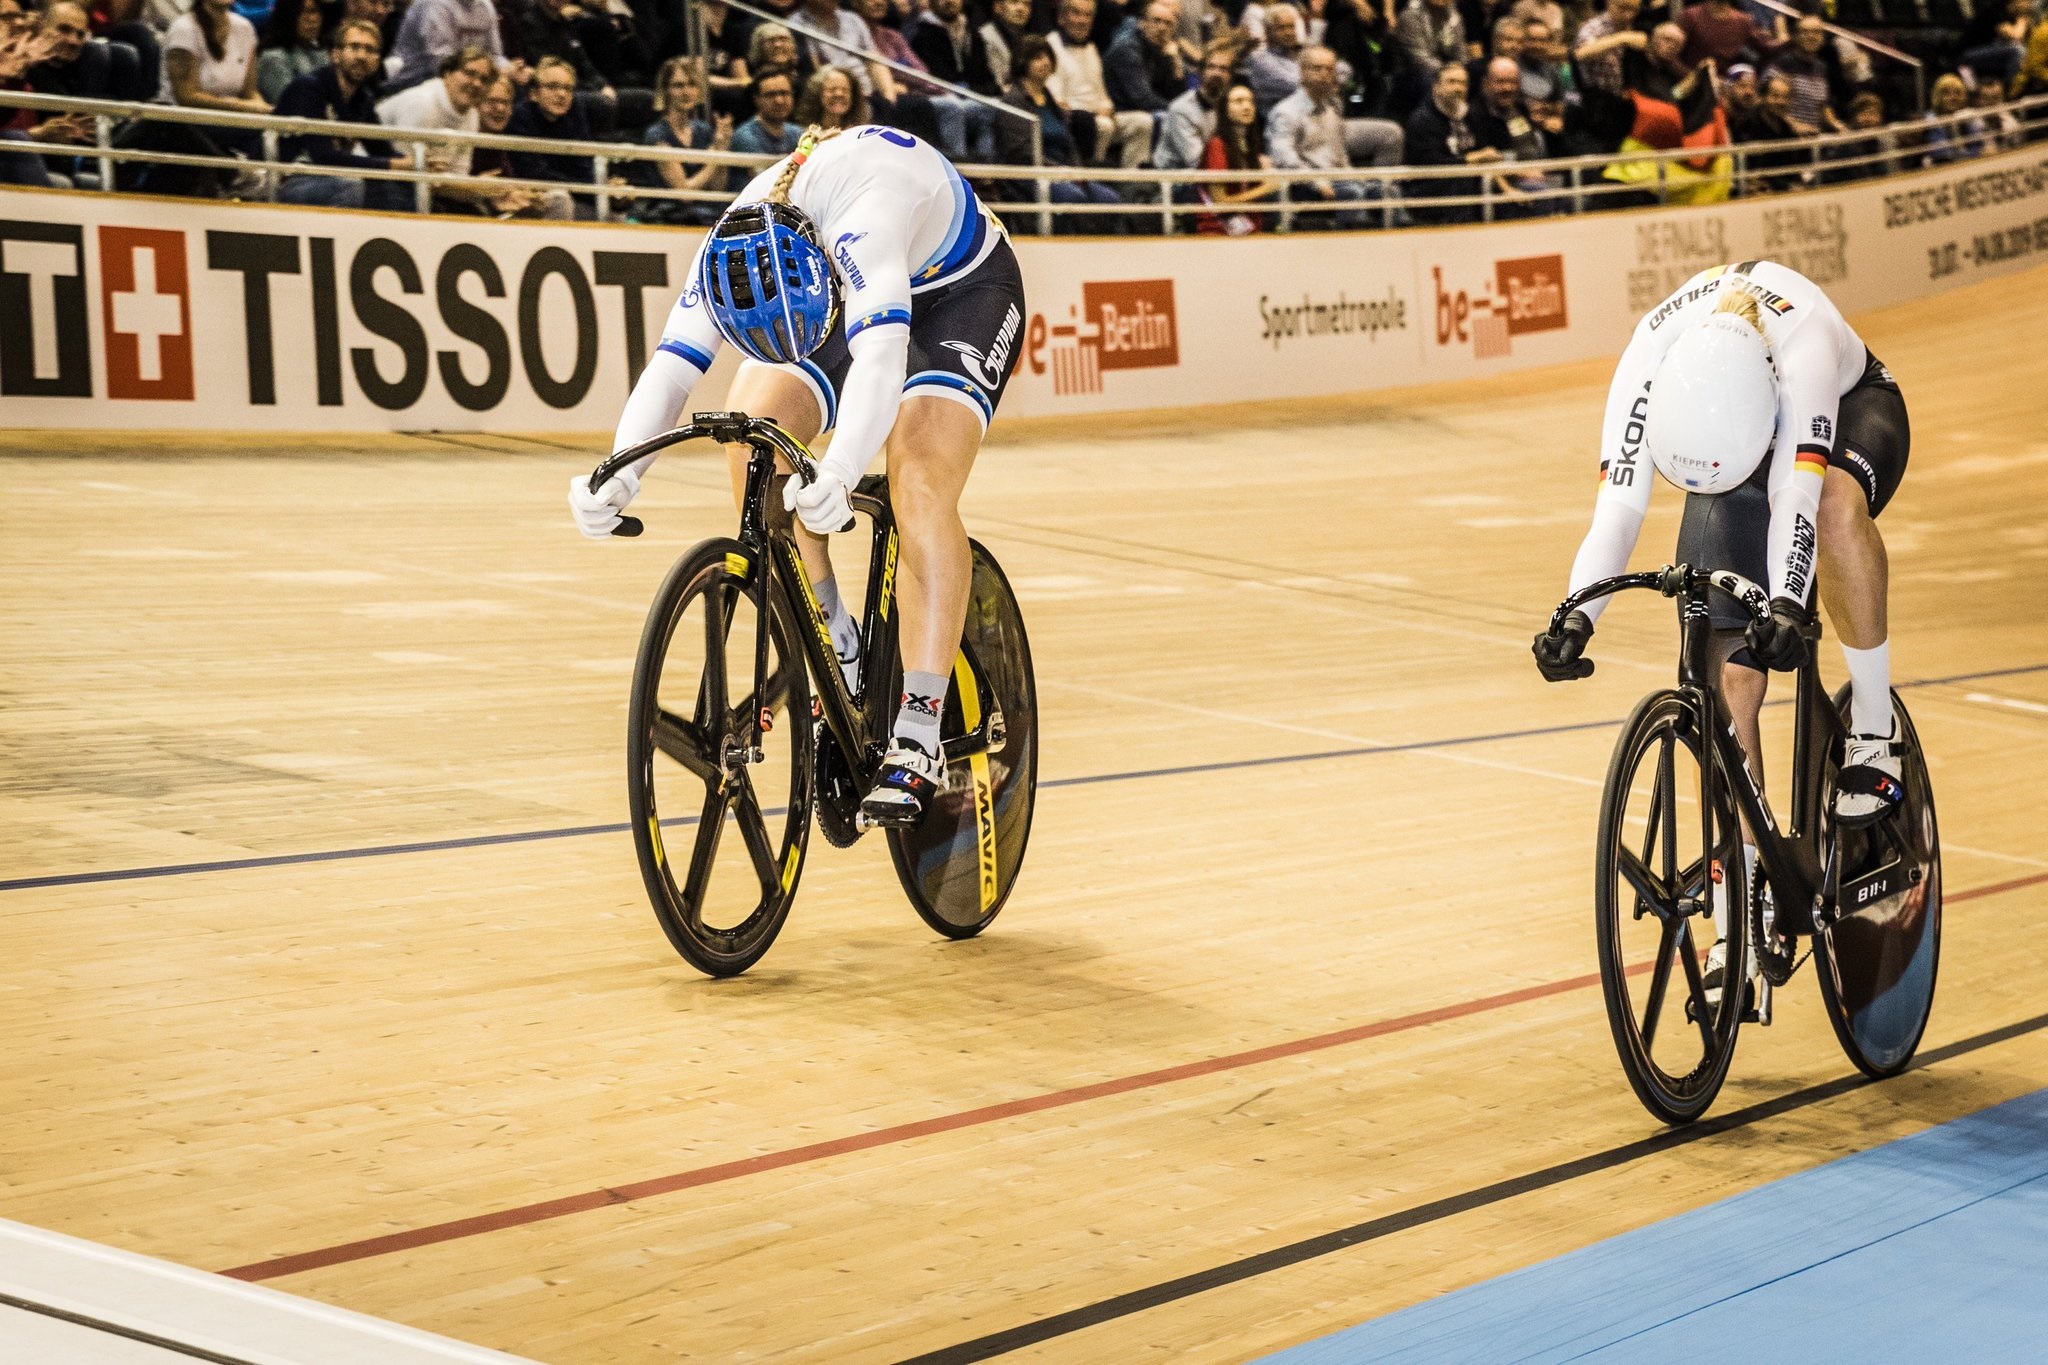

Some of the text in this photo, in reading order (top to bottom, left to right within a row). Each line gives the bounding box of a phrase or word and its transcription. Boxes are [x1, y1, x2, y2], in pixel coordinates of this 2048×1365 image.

[839, 252, 867, 292] GAZPROM
[205, 229, 669, 412] TISSOT
[989, 302, 1022, 372] GAZPROM
[1012, 301, 1172, 376] e Berlin
[1259, 285, 1407, 351] Sportmetropole
[1672, 453, 1709, 469] KIEPPE
[879, 525, 900, 624] EDGE
[976, 779, 994, 896] MAVIC
